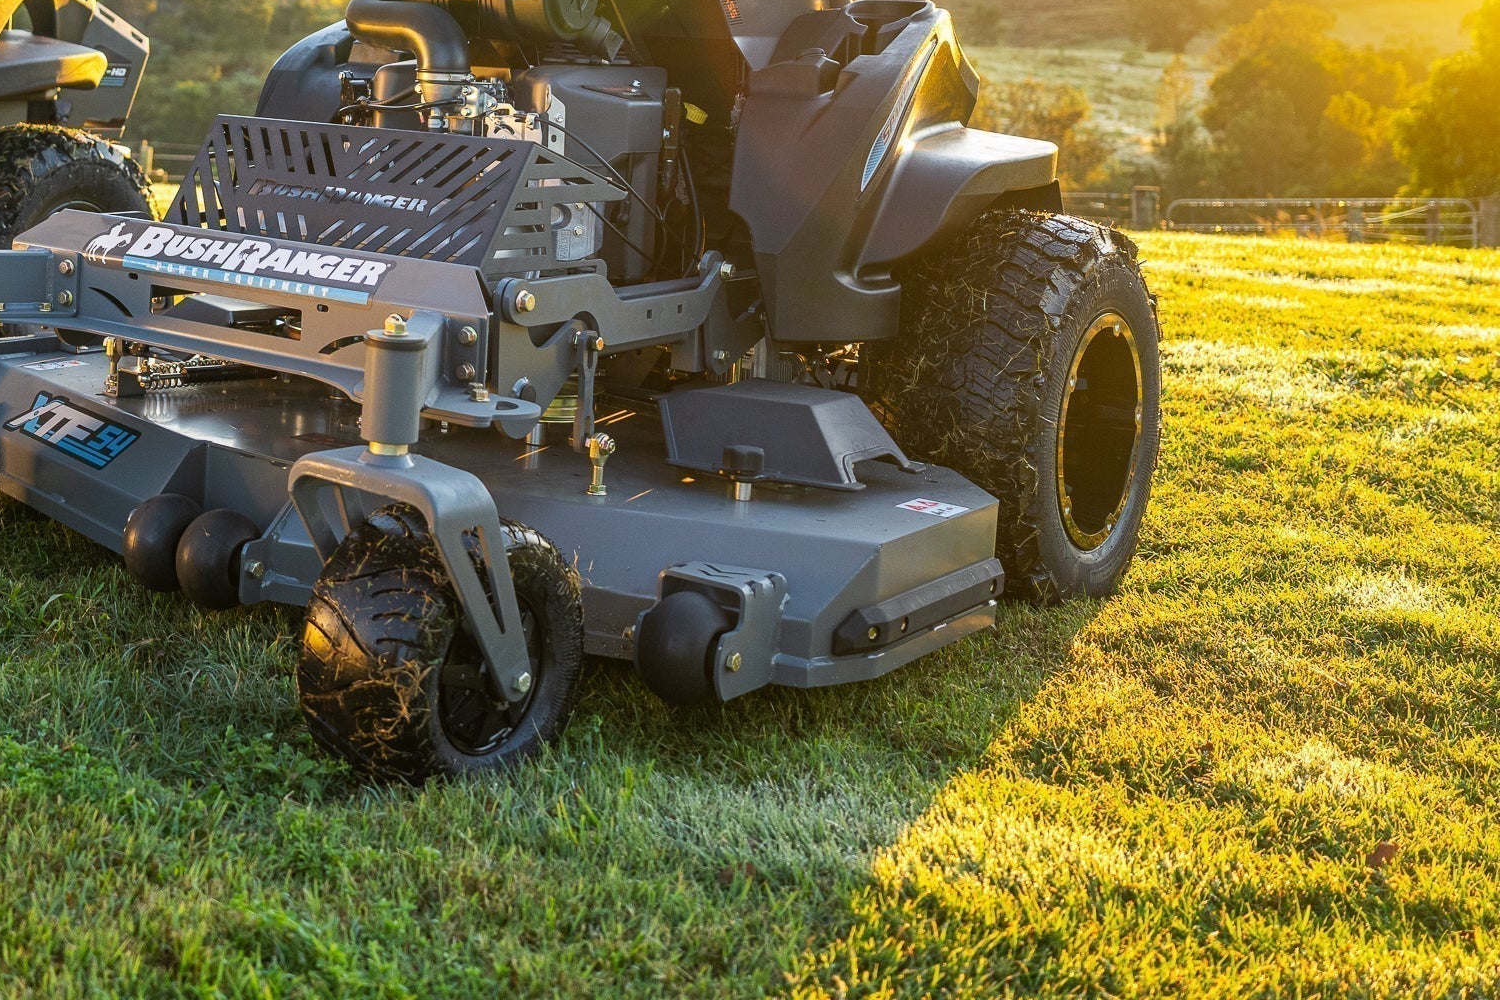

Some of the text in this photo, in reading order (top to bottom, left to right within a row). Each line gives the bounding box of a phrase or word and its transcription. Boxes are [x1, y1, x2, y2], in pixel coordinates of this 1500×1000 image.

[155, 261, 331, 298] POWER EQUIPMENT
[87, 424, 138, 458] 54
